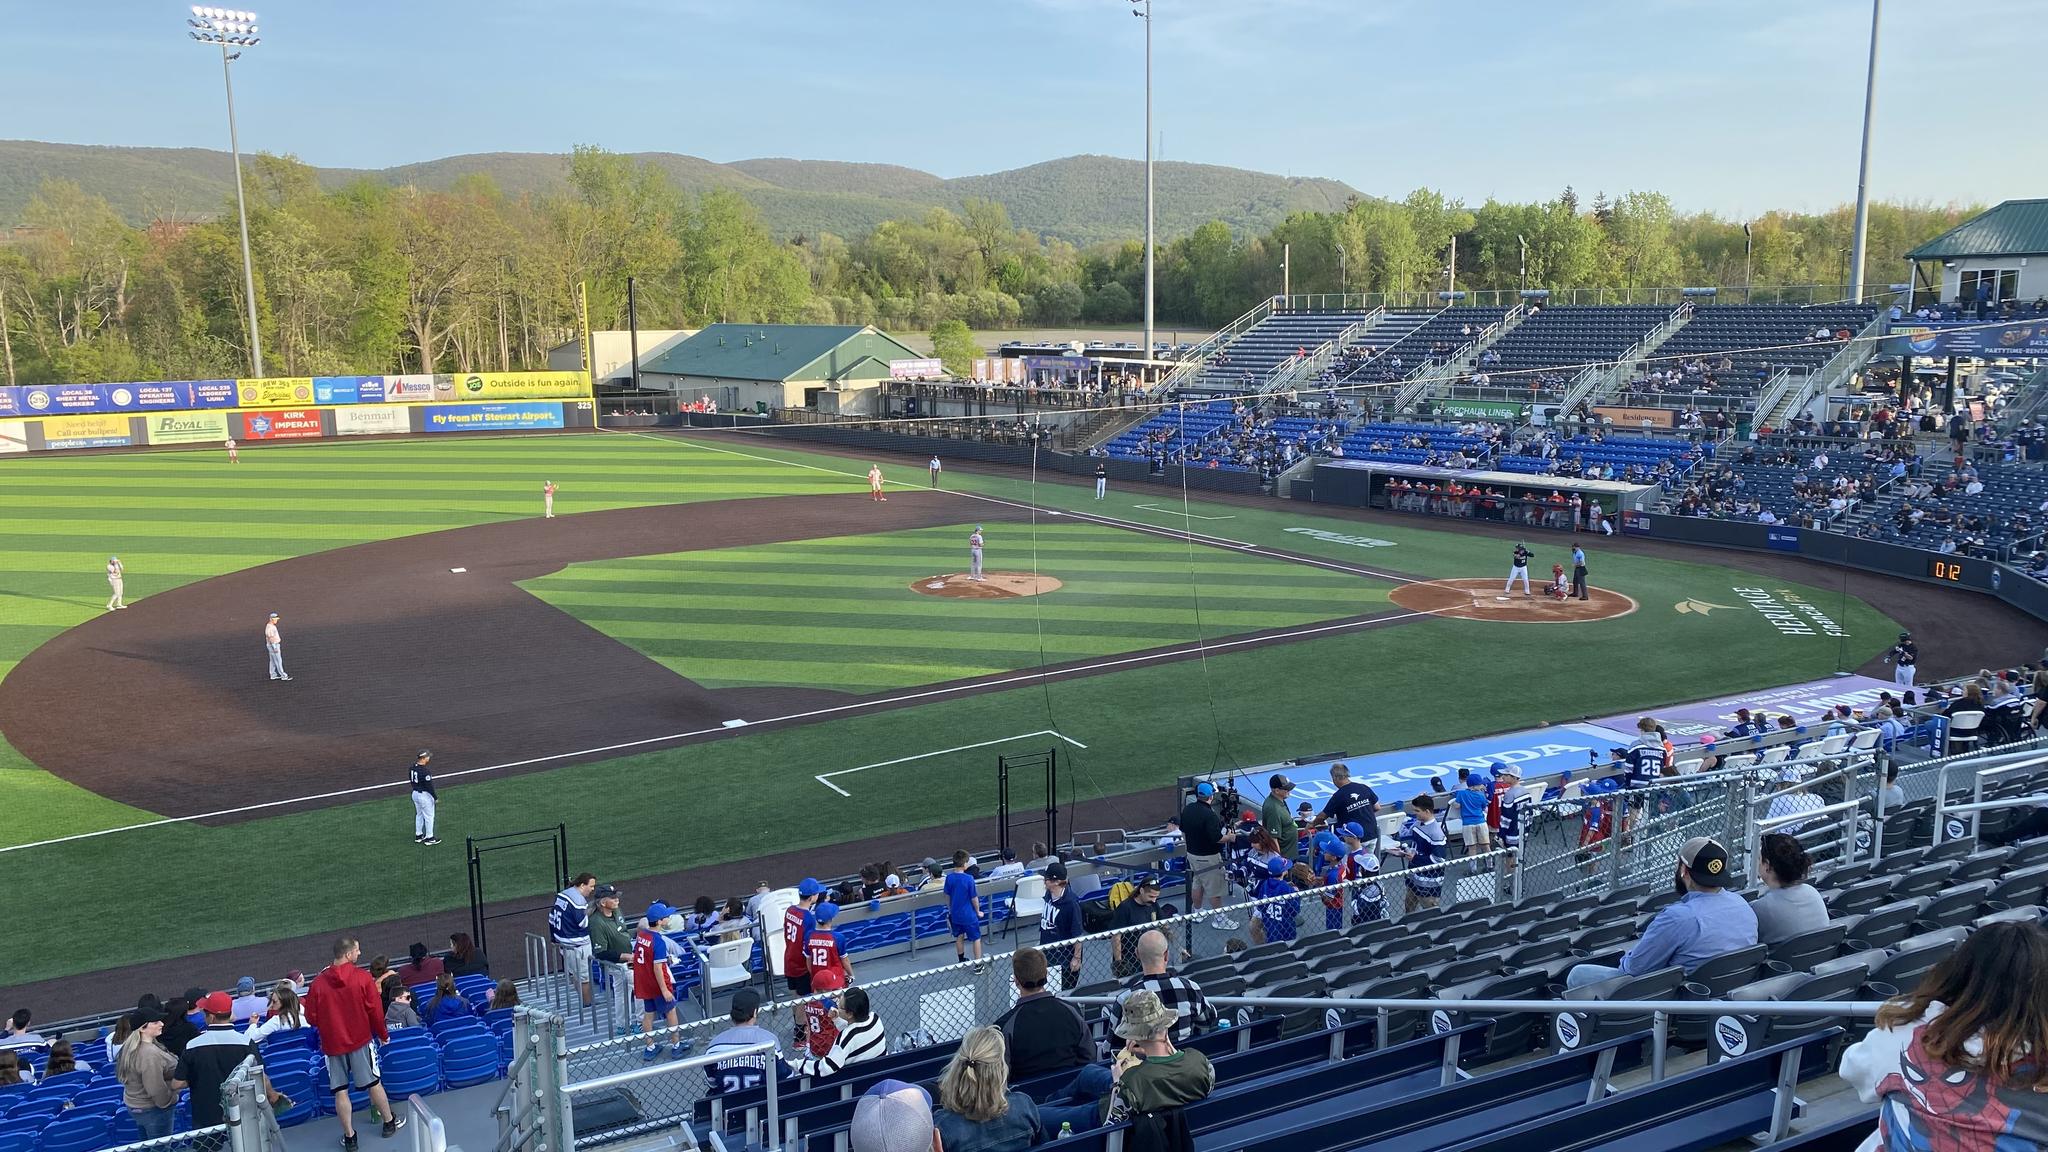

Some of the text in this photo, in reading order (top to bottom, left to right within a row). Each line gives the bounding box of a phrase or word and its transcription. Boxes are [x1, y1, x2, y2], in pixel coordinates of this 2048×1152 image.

[402, 383, 431, 391] Messco
[490, 380, 526, 388] Outside
[554, 379, 580, 387] again.
[350, 410, 395, 421] Benmarl
[433, 415, 446, 424] Fly
[448, 414, 470, 422] from
[485, 412, 520, 421] Stewart
[522, 411, 555, 421] Airport.
[1444, 406, 1488, 416] PRECHAUN
[160, 418, 202, 430] ROYAL
[1732, 587, 1817, 635] HERITAGE
[1350, 743, 1594, 788] HONDA
[1641, 759, 1660, 776] 25
[411, 770, 418, 783] 13
[1266, 901, 1282, 921] 42
[637, 947, 644, 964] 3
[812, 948, 827, 966] 12
[810, 1016, 820, 1033] 8
[717, 1054, 766, 1070] RENEGADES
